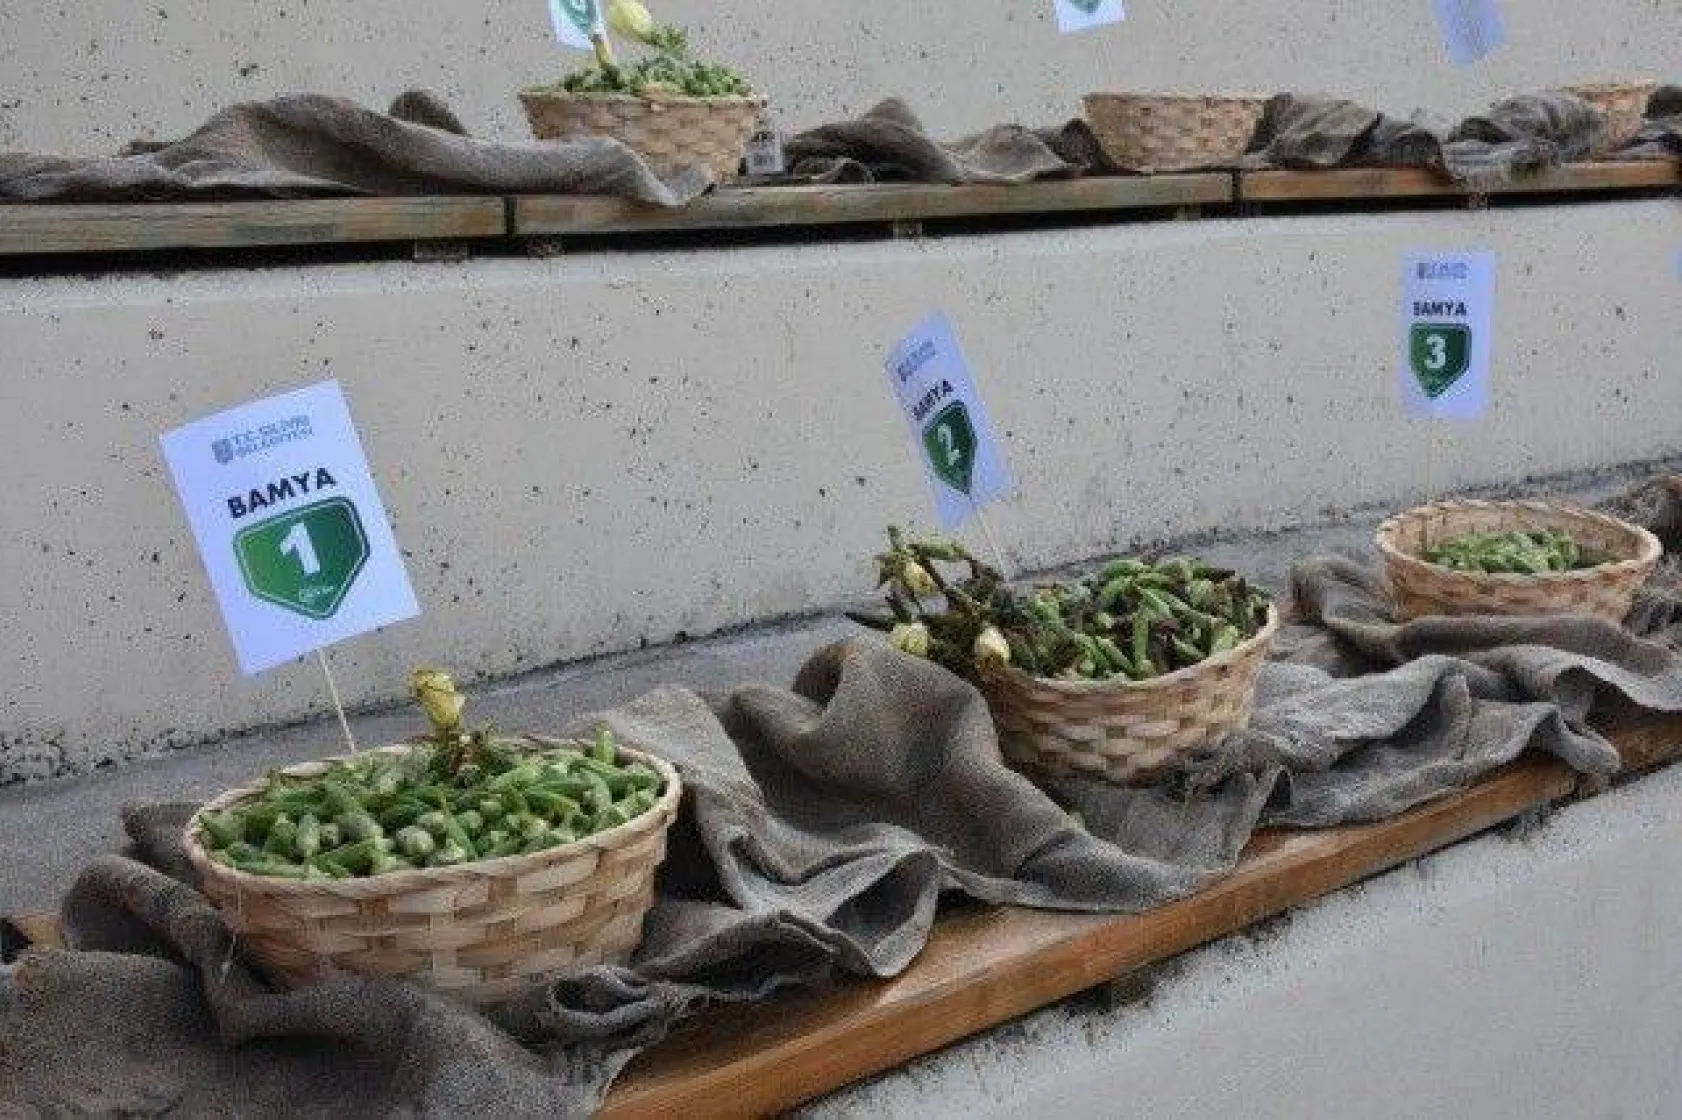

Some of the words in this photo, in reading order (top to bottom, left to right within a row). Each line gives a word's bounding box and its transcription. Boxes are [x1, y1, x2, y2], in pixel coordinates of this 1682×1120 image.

[1424, 334, 1446, 369] 3
[937, 422, 963, 466] 2
[227, 467, 336, 519] BAMYA
[279, 522, 321, 576] 1
